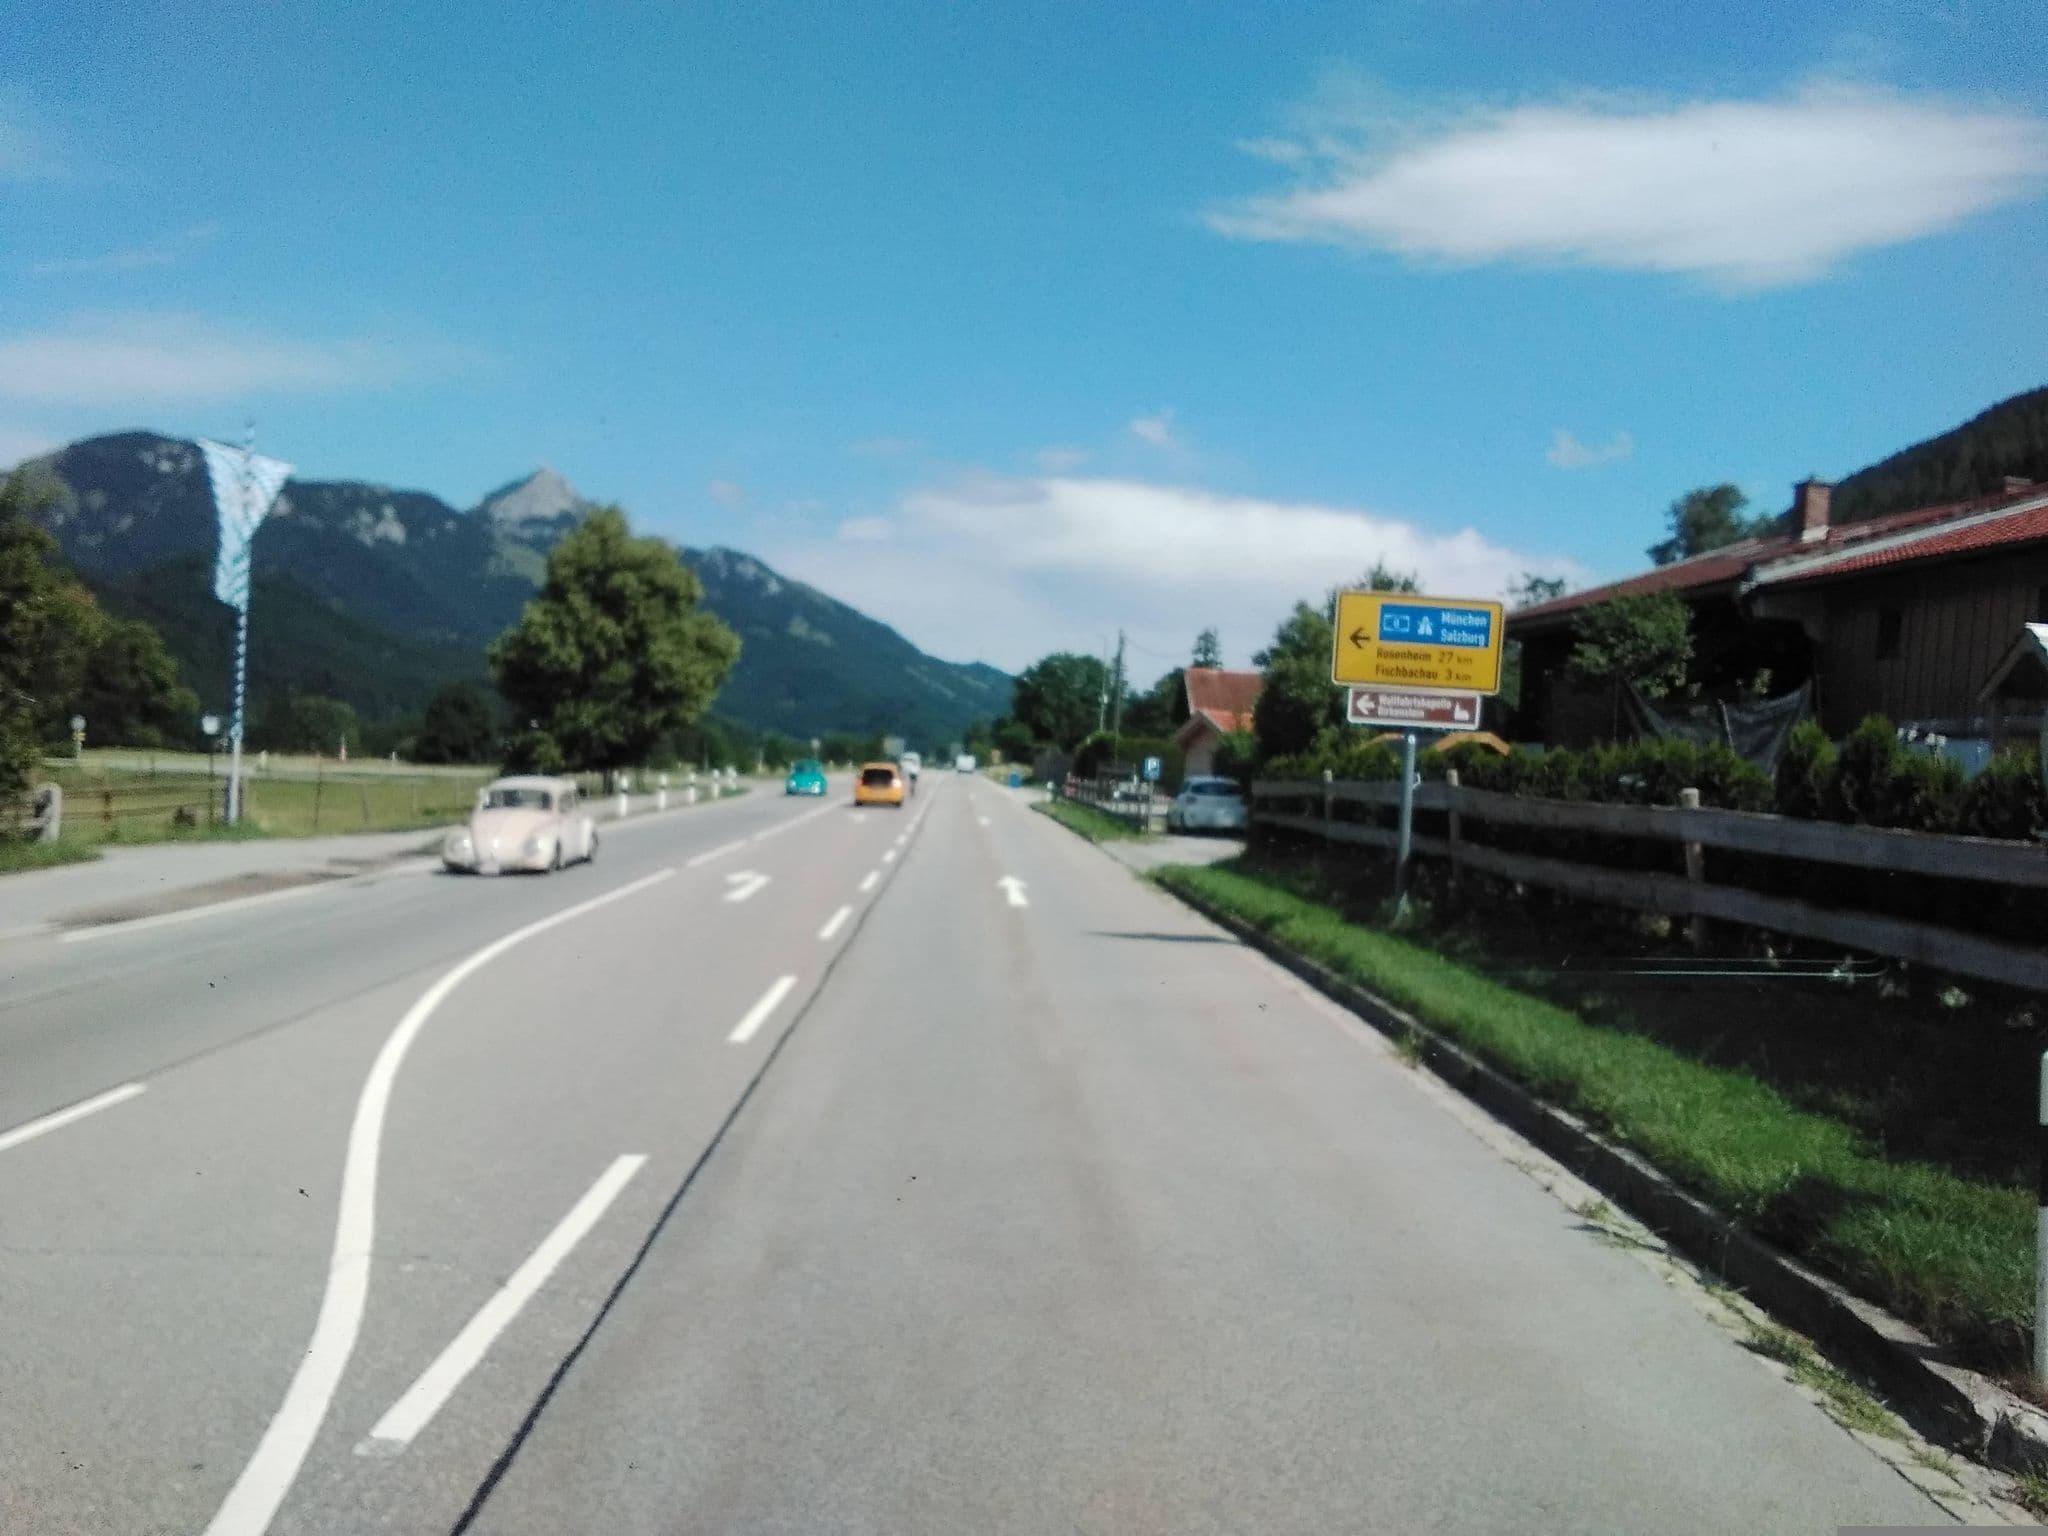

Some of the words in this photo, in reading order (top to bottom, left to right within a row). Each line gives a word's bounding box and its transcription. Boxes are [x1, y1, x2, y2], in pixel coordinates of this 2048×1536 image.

[1441, 612, 1487, 627] München
[1441, 628, 1485, 646] Salzburg
[1376, 648, 1431, 662] Rosenheim
[1438, 651, 1453, 663] 27
[1456, 655, 1473, 665] km
[1375, 664, 1438, 680] Fischbachau
[1455, 672, 1472, 682] km
